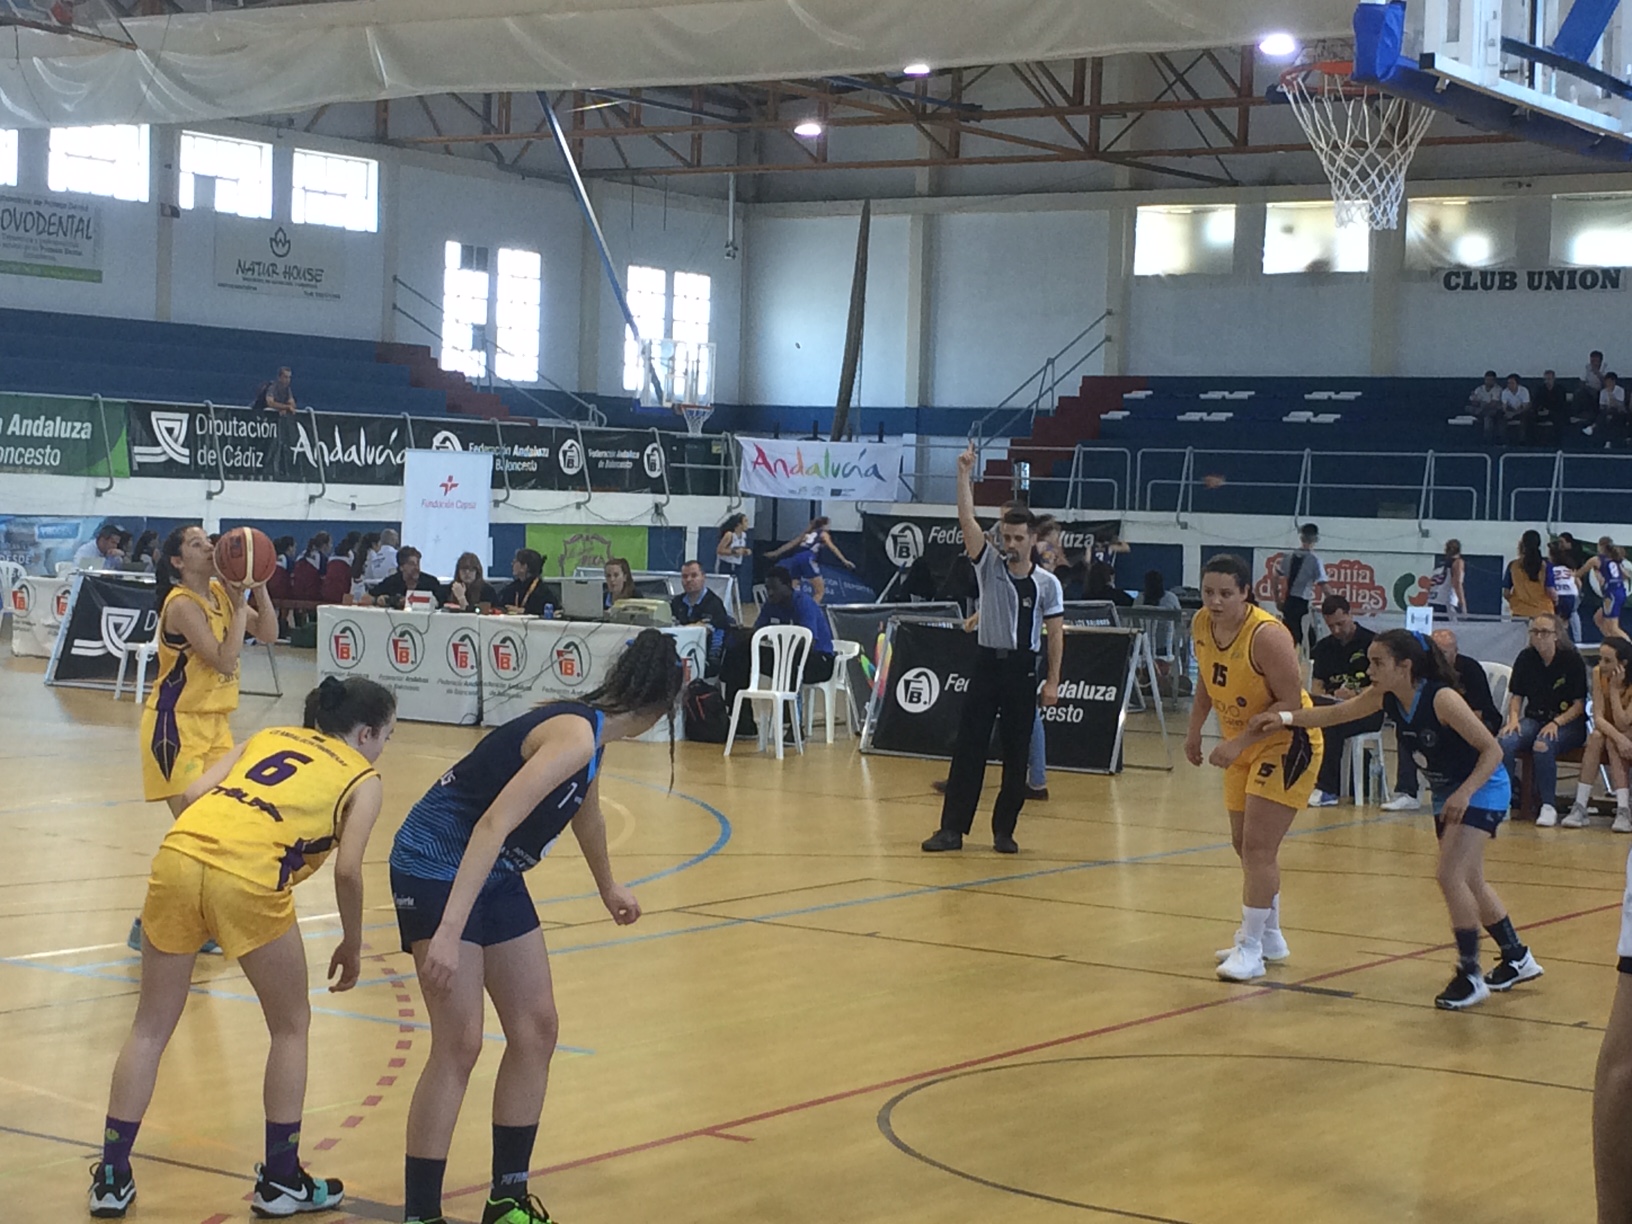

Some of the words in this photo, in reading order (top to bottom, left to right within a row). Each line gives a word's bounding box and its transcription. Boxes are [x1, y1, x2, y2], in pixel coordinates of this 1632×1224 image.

[236, 259, 279, 278] NATUR
[282, 265, 324, 283] HOUSE
[1443, 271, 1517, 291] CLUB
[1527, 269, 1621, 290] UNION
[6, 413, 92, 440] Andaluza
[195, 413, 278, 438] Diputación
[197, 446, 217, 466] de
[222, 445, 264, 468] Cádiz
[290, 422, 406, 467] Andalucía
[751, 442, 887, 483] Andalucía
[1212, 662, 1228, 687] 15
[245, 750, 314, 786] 6
